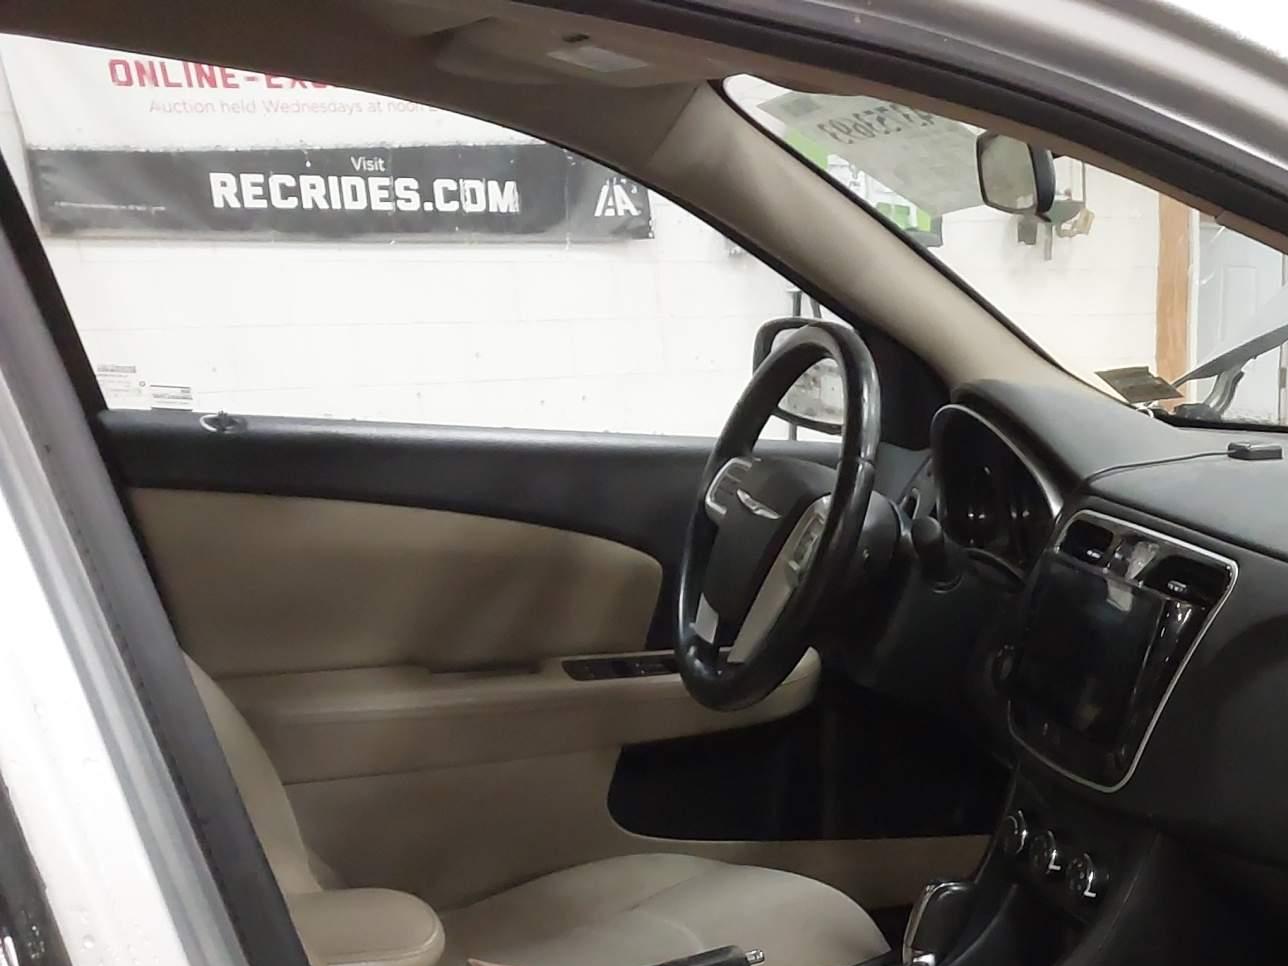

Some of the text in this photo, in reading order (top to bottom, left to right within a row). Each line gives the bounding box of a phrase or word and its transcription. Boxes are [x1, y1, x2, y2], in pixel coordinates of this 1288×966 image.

[149, 100, 215, 113] Auction
[221, 99, 256, 113] held
[262, 100, 362, 117] Wednesdays
[367, 101, 383, 113] at
[350, 156, 386, 172] Visit
[209, 172, 520, 213] RECRIDES.COM
